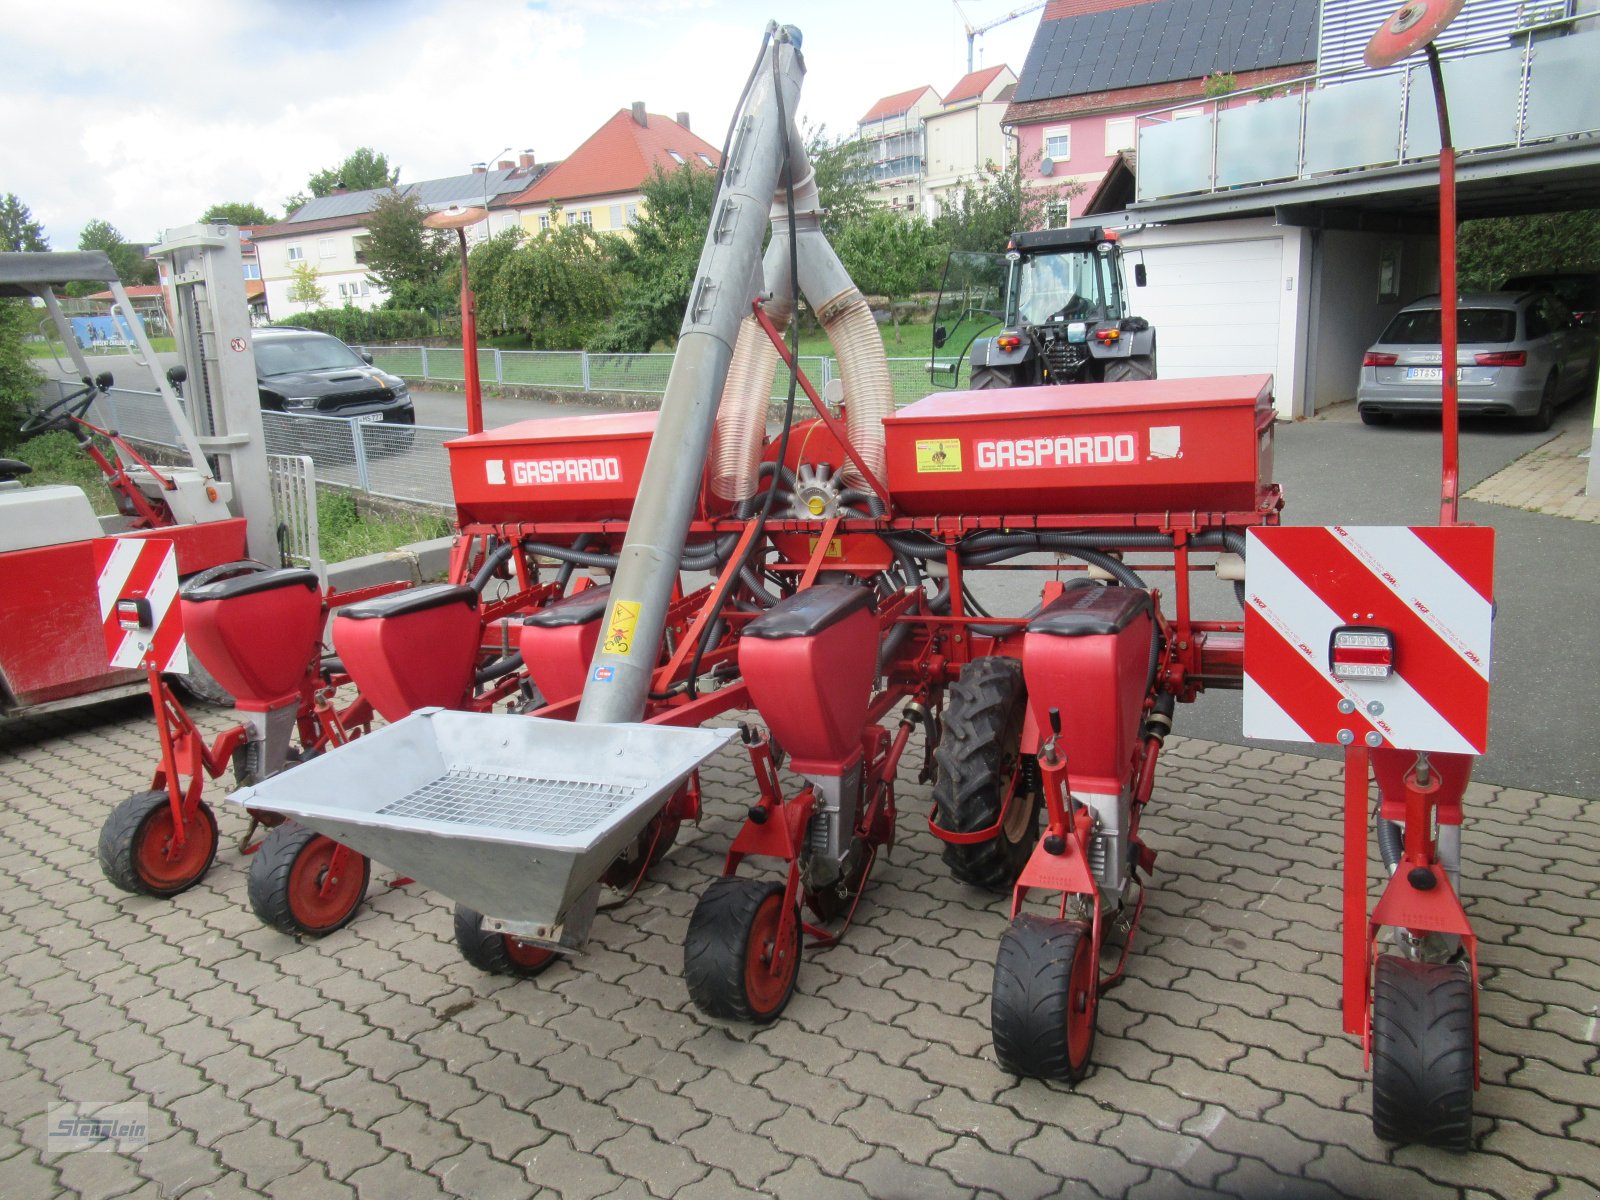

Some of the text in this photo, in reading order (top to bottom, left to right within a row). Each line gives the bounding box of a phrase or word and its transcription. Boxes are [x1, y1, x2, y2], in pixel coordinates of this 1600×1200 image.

[1413, 369, 1424, 377] BT
[977, 434, 1134, 468] GASPARDO
[513, 458, 619, 484] GASPARDO
